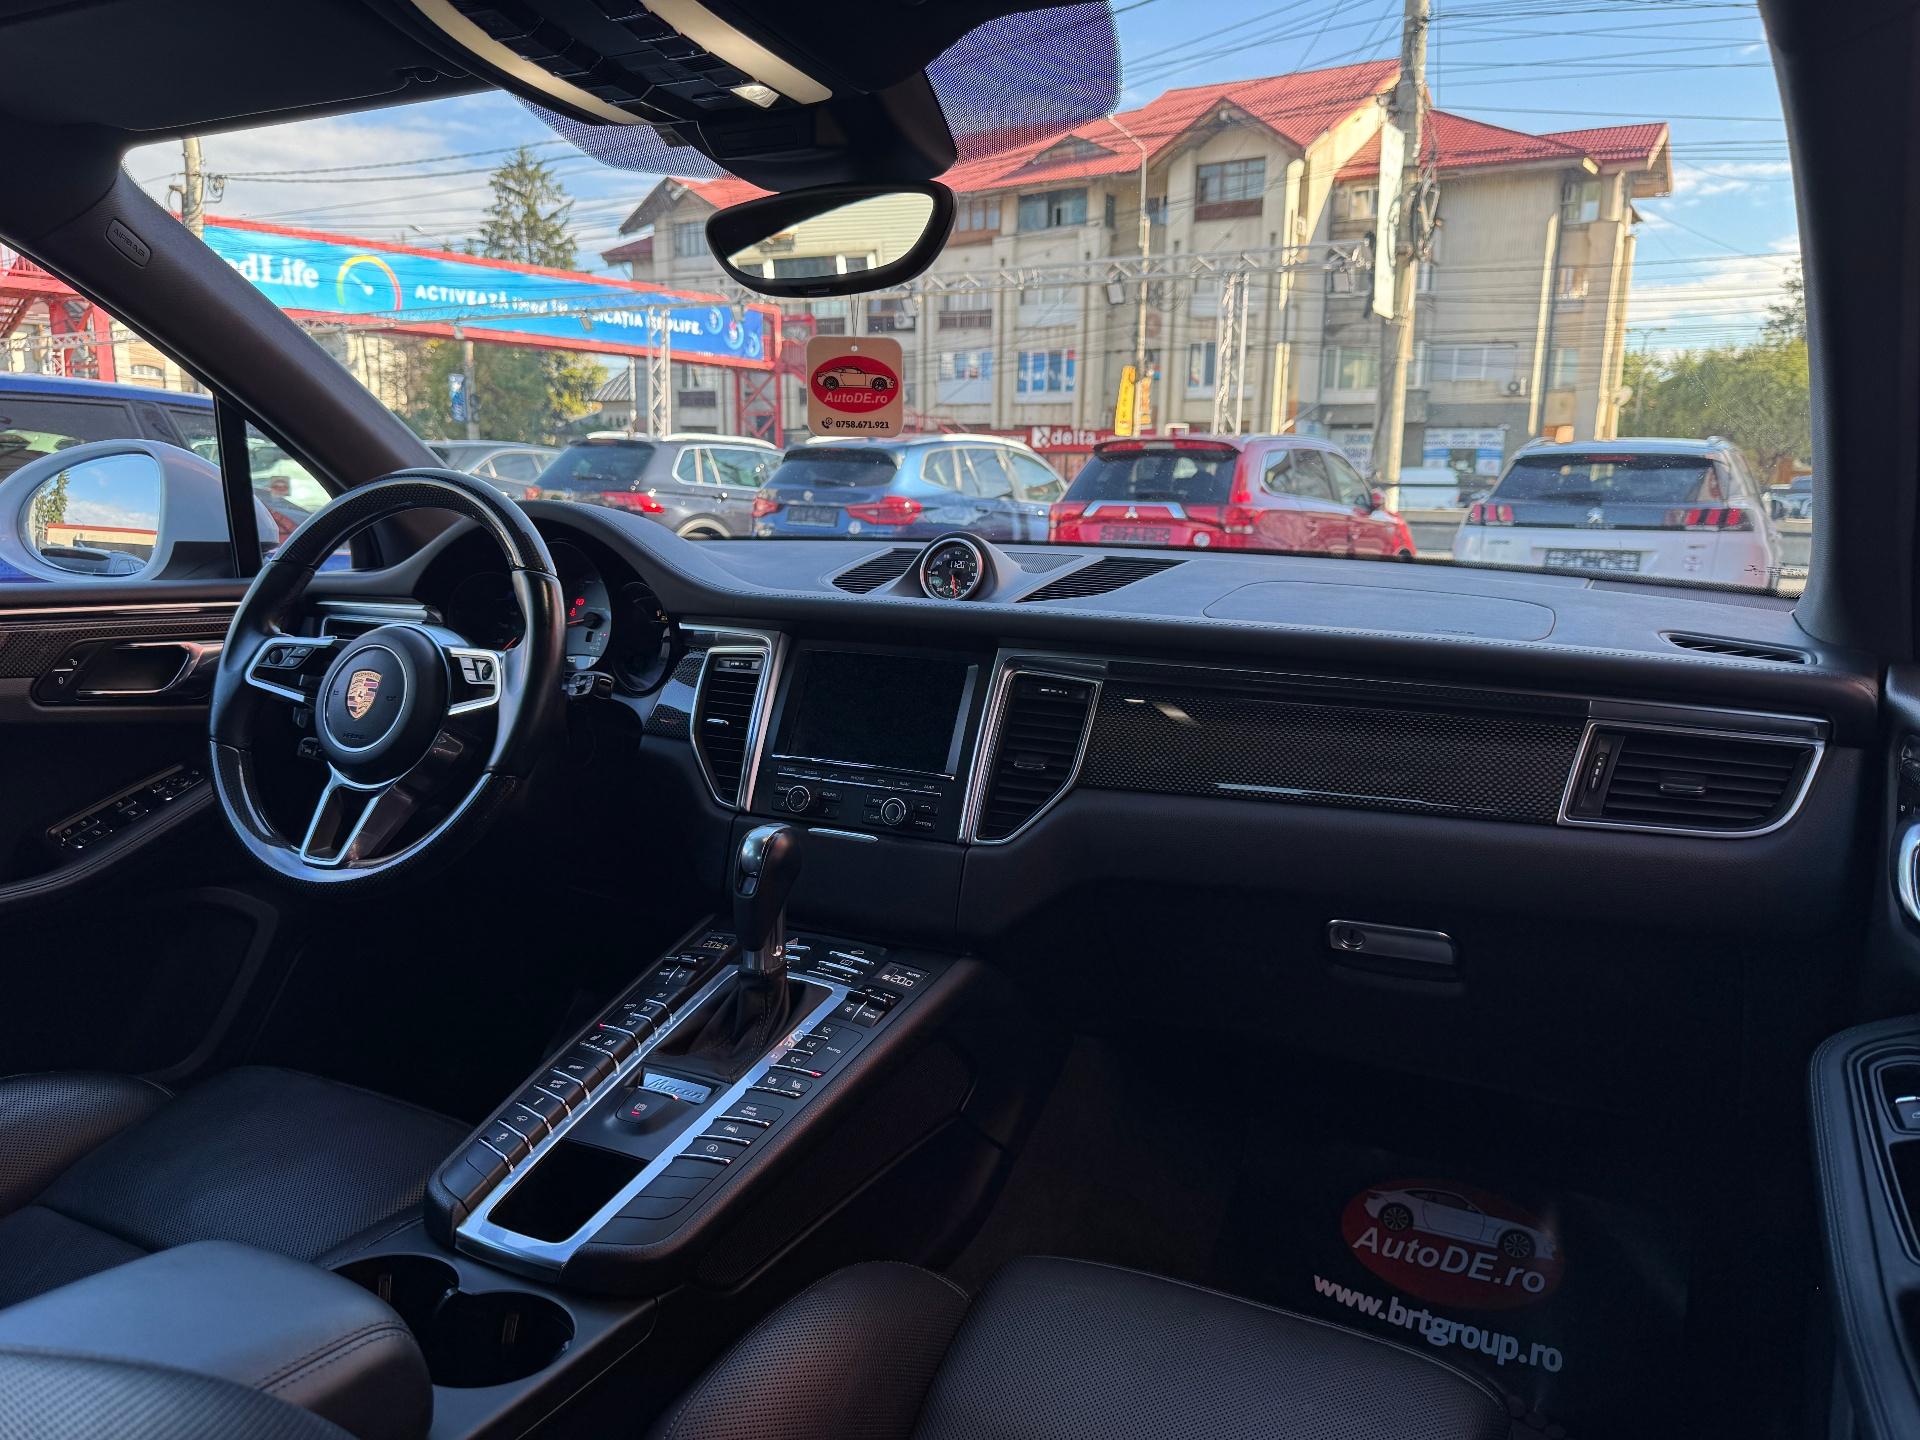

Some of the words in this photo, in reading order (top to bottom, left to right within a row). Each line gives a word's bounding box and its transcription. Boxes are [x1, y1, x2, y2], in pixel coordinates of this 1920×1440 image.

[824, 392, 888, 404] AutoDE.ro
[1051, 430, 1097, 446] delta
[647, 1078, 705, 1100] Macan
[1352, 1226, 1547, 1294] AutoDE.ro
[1312, 1272, 1564, 1374] www.brtgroup.ro
